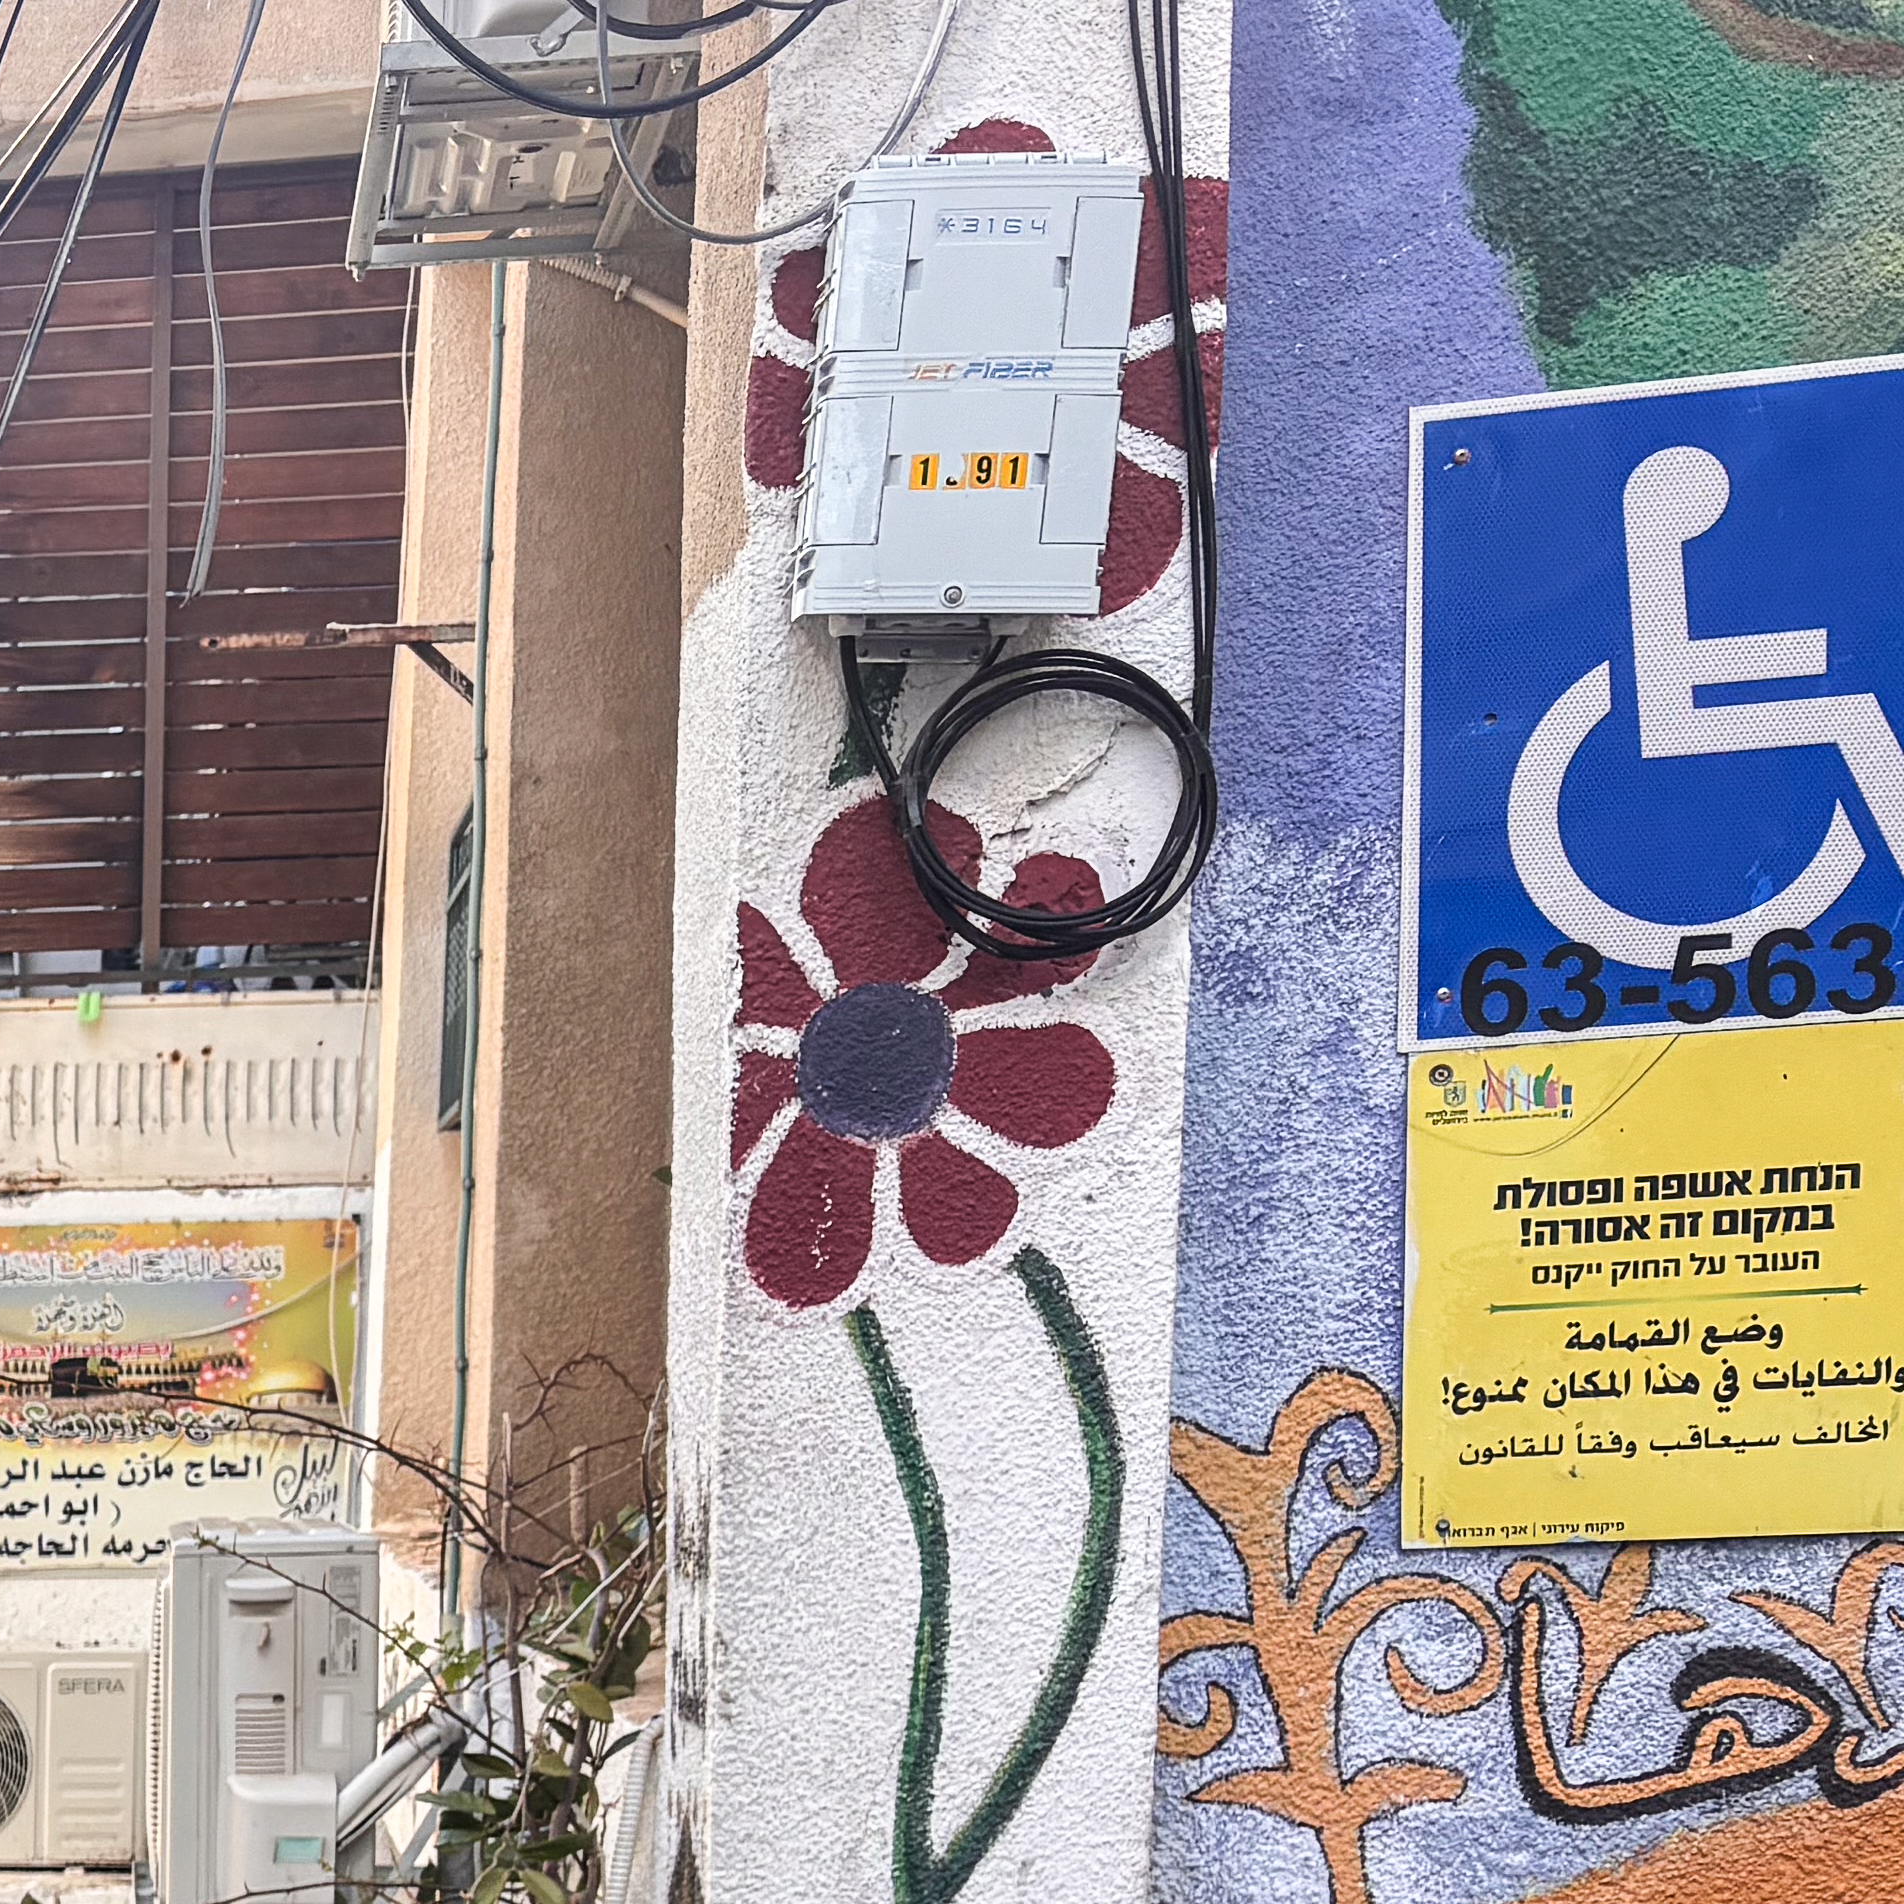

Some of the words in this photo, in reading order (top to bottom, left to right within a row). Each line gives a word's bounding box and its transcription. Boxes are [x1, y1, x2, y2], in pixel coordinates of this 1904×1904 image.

[962, 360, 1054, 380] FIBER
[1459, 922, 1895, 1037] 63-563
[1493, 1177, 1624, 1211] ופסולת
[1634, 1169, 1752, 1201] אשפה
[1760, 1162, 1861, 1194] הנחת
[1520, 1214, 1651, 1247] אסורה!
[1659, 1211, 1703, 1238] זה
[1712, 1204, 1835, 1243] במקום
[1532, 1261, 1602, 1289] ייקנס
[1611, 1257, 1680, 1287] החוק
[1690, 1253, 1726, 1277] על
[1734, 1250, 1820, 1273] העובר
[1565, 1317, 1689, 1352] القمامة
[1700, 1313, 1783, 1355] وضع
[1545, 1367, 1631, 1408] المكان
[1645, 1363, 1699, 1396] هذا
[1713, 1358, 1738, 1413] في
[1649, 1425, 1780, 1454] سيعاقب
[1791, 1415, 1889, 1446] المخالف
[1459, 1433, 1564, 1466] للقانون
[51, 1460, 106, 1488] عبد
[117, 1452, 173, 1486] مازن
[185, 1454, 262, 1487] الحاج
[1541, 1523, 1580, 1535] עירוני
[1584, 1521, 1625, 1535] פיקוח
[103, 1533, 172, 1563] حرمه
[58, 1678, 125, 1695] SFERA
